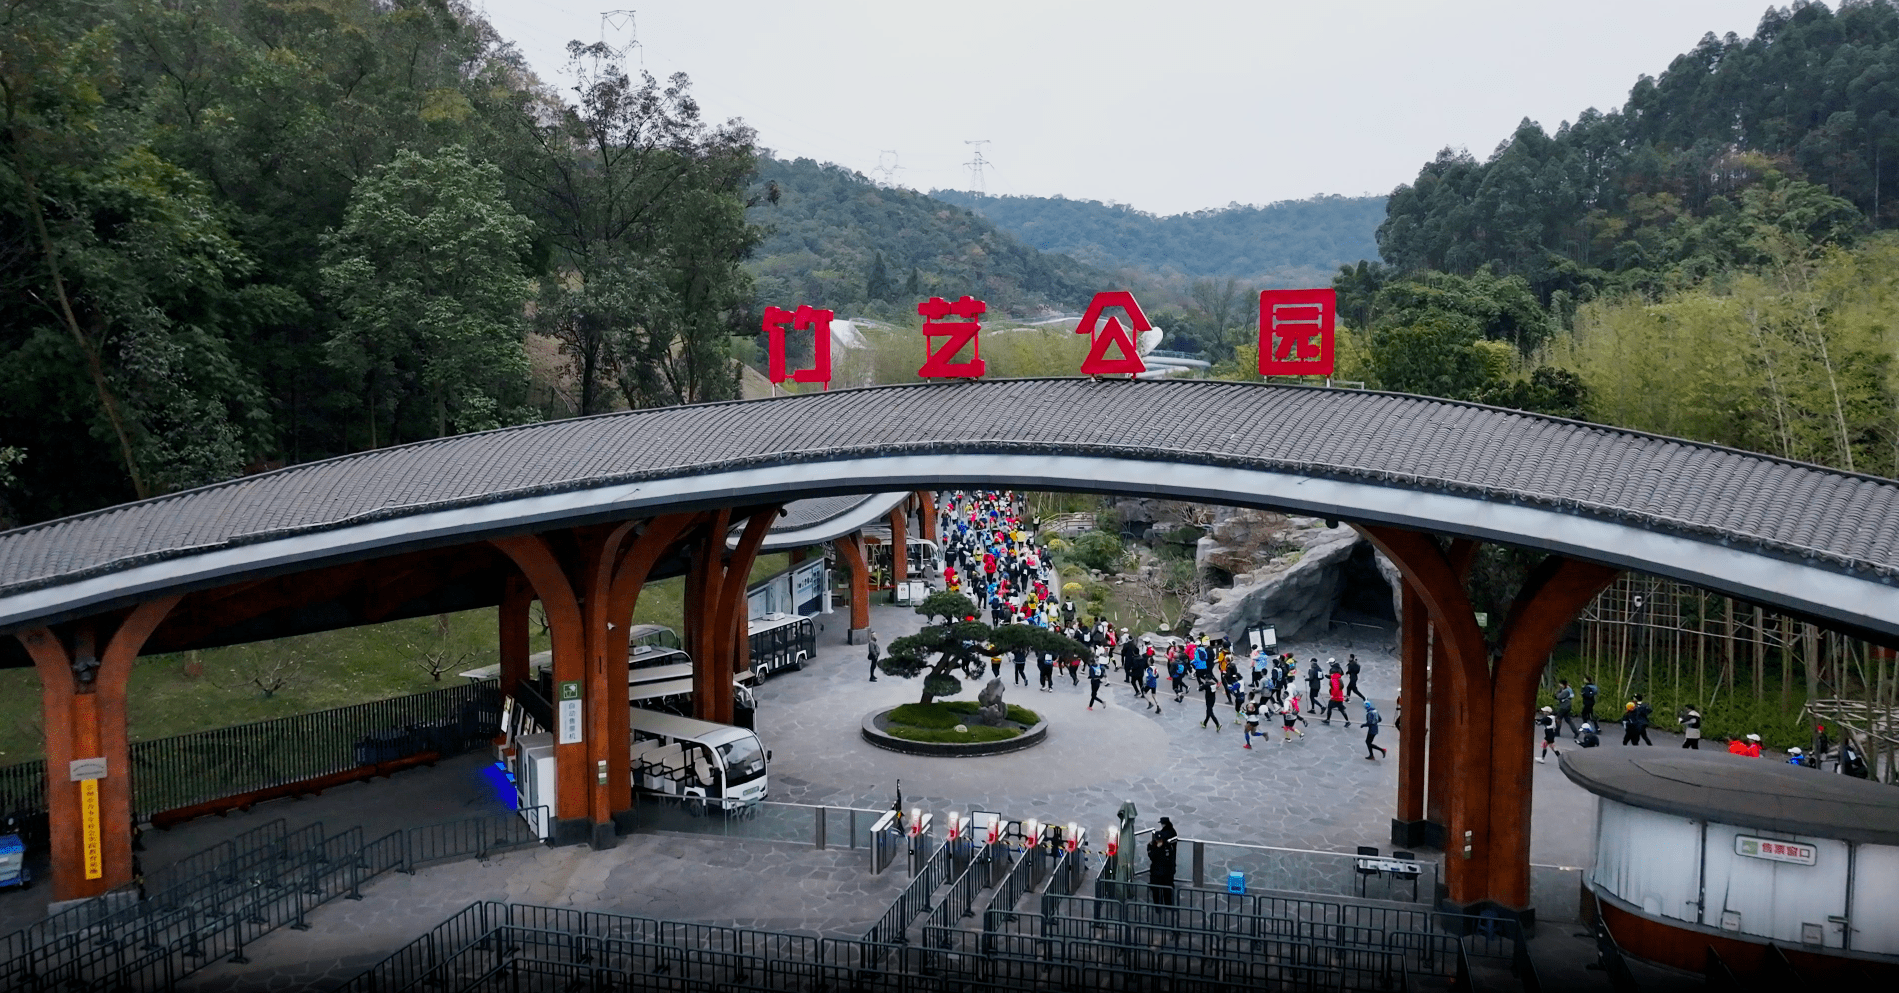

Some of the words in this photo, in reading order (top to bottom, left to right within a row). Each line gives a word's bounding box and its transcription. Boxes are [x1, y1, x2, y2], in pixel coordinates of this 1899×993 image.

[762, 288, 1337, 386] 竹艺公园
[1762, 842, 1810, 858] 售票窗口
